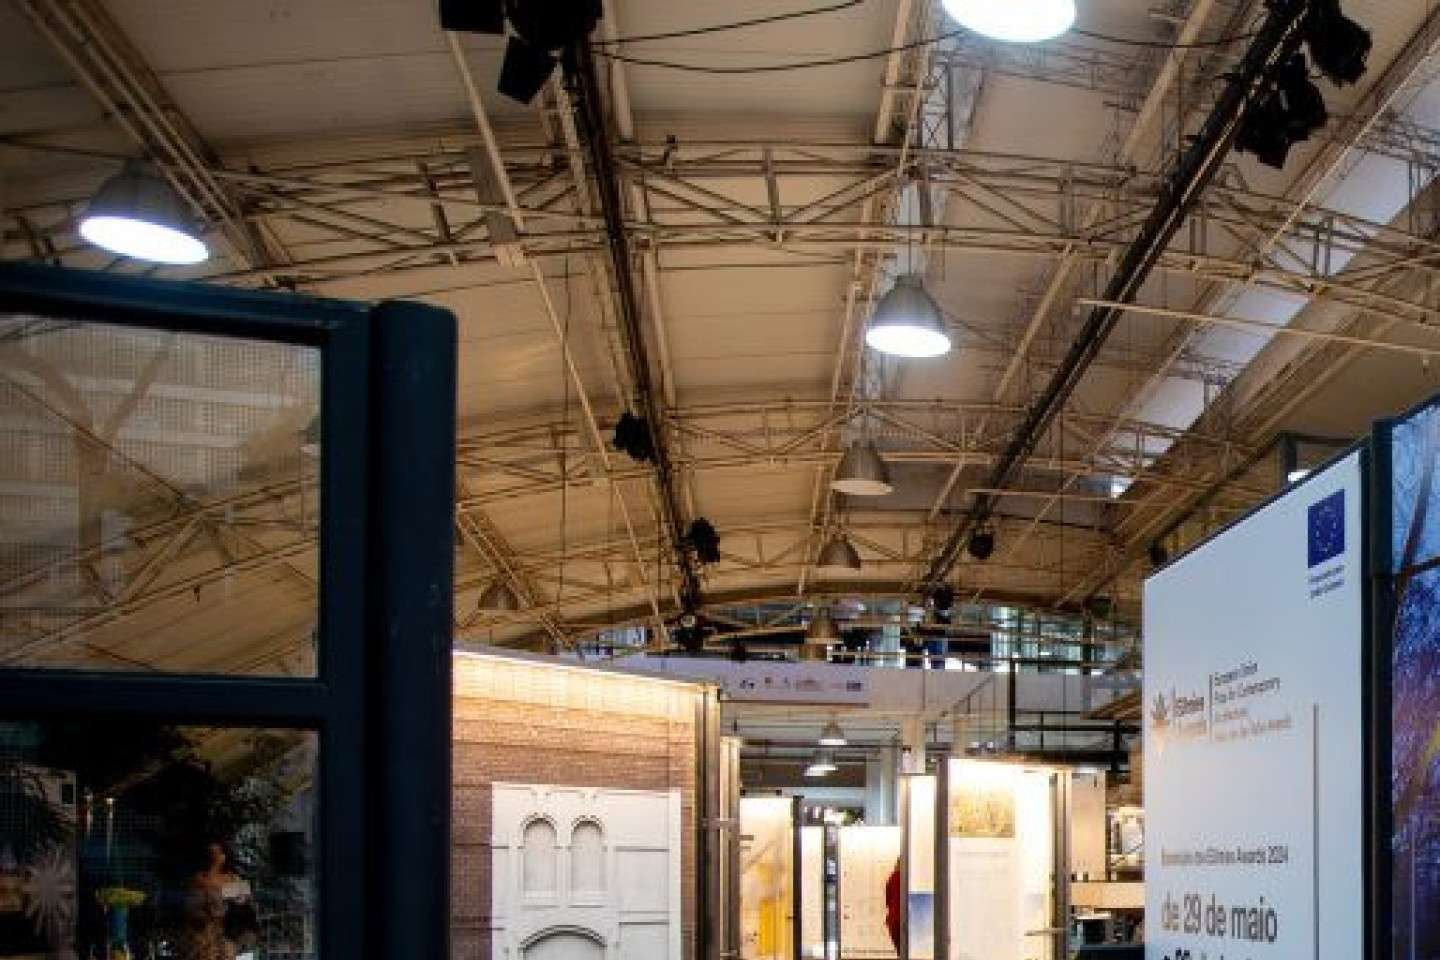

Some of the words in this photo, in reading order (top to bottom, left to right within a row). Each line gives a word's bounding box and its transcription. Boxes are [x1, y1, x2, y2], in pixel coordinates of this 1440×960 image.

[1162, 891, 1180, 932] de
[1184, 893, 1201, 935] 29
[1206, 893, 1227, 937] de
[1231, 895, 1278, 943] maio
